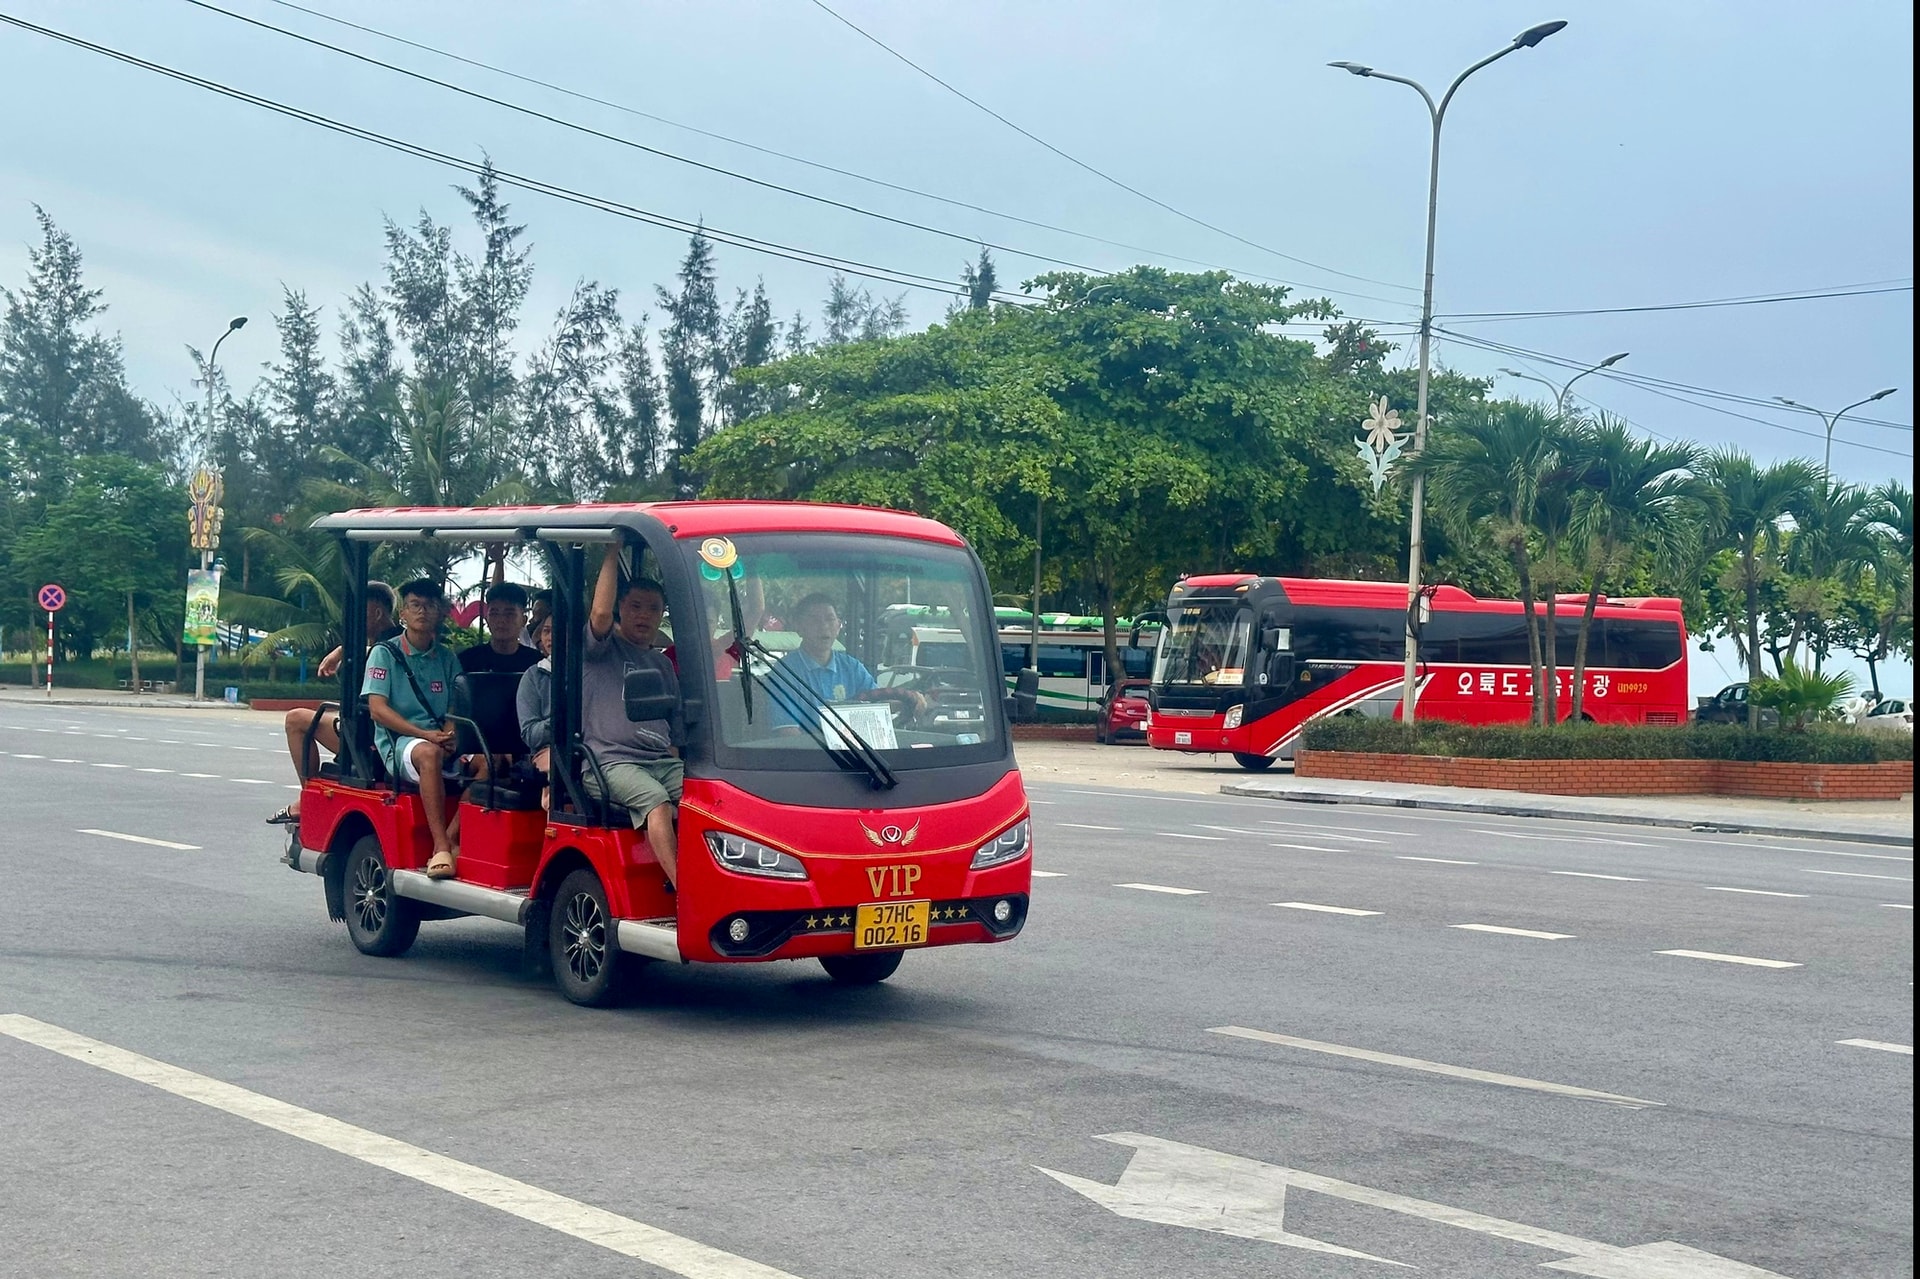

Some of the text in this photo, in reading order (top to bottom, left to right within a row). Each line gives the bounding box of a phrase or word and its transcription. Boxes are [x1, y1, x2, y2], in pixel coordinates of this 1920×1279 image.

[865, 864, 921, 898] VIP
[873, 904, 915, 925] 37HC
[864, 924, 921, 946] 002.16
